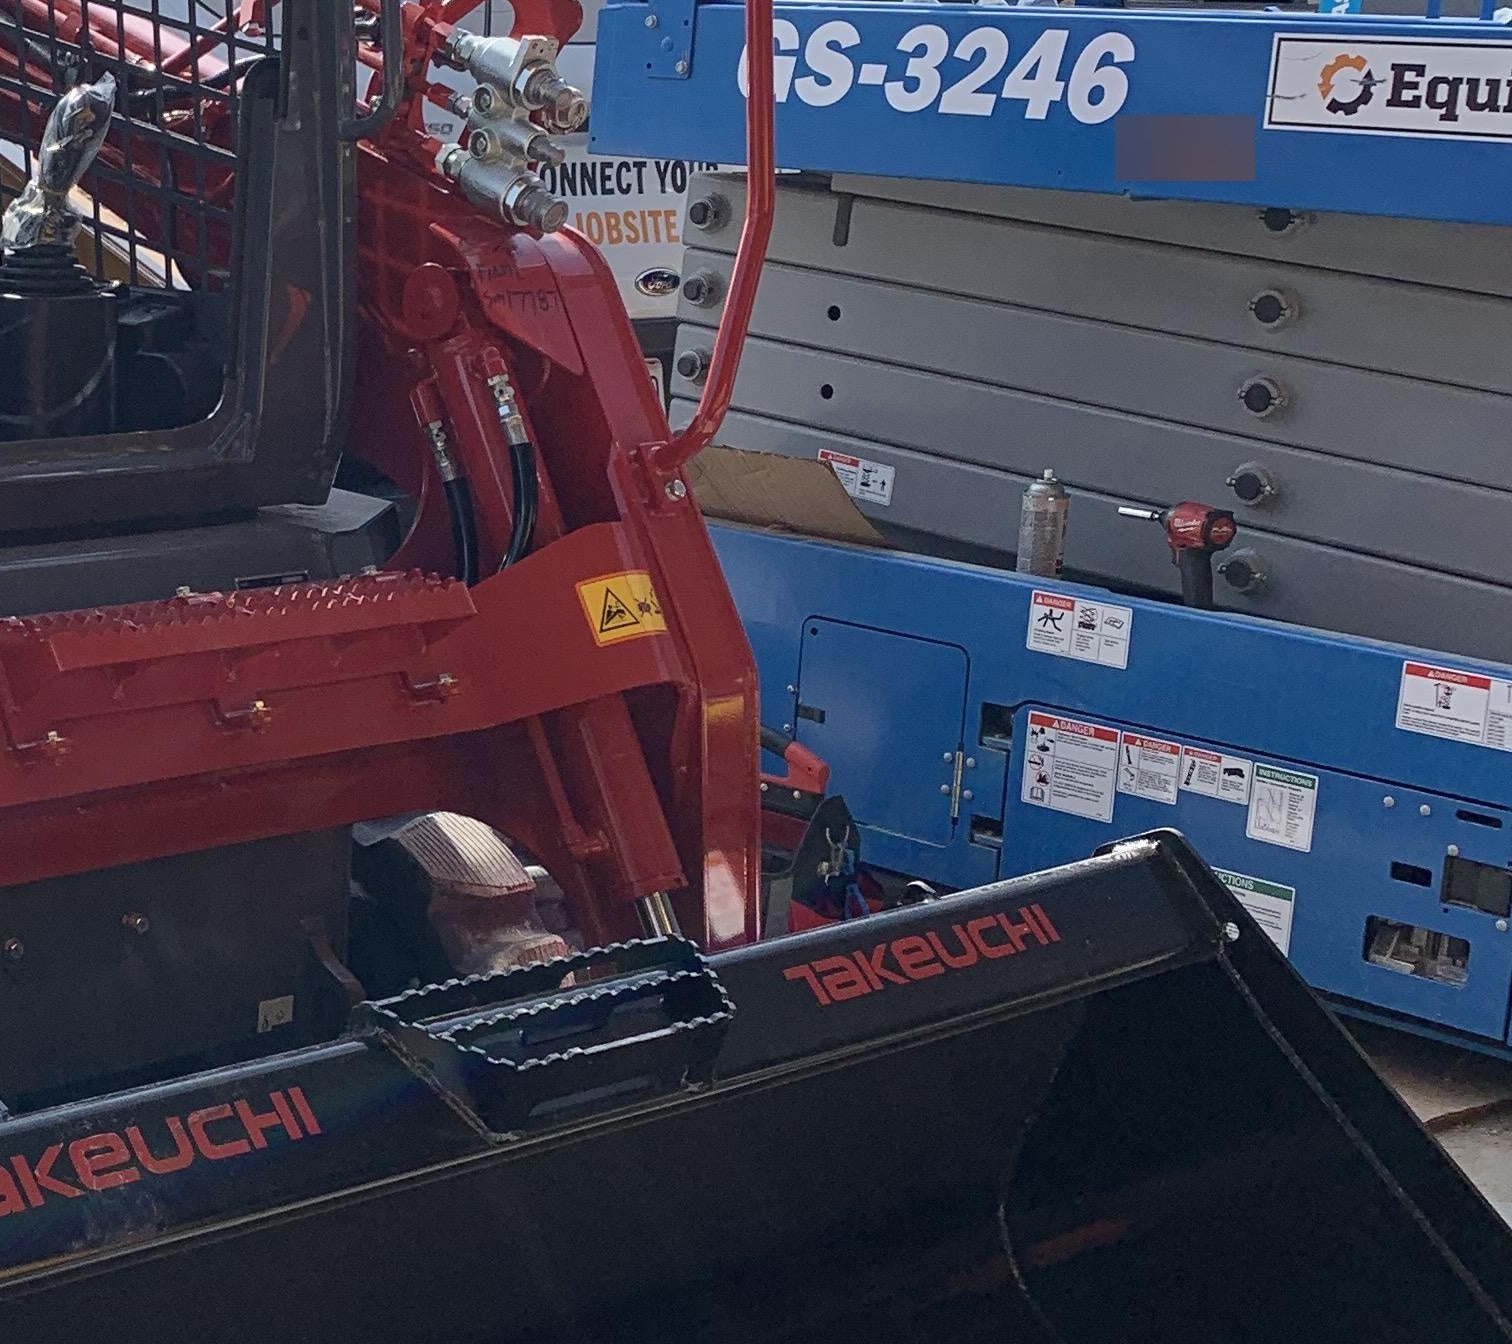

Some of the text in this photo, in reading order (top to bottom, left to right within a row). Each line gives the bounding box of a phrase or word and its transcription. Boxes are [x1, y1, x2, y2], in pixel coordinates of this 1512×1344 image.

[737, 18, 1136, 126] GS-3246
[540, 161, 647, 196] ONNECT
[1043, 598, 1072, 608] DANGER
[1060, 721, 1095, 737] DANGER
[1142, 740, 1172, 753] DANGER
[1258, 768, 1313, 787] INSTRUCTIONS
[783, 904, 1062, 1008] TAKEUCHI
